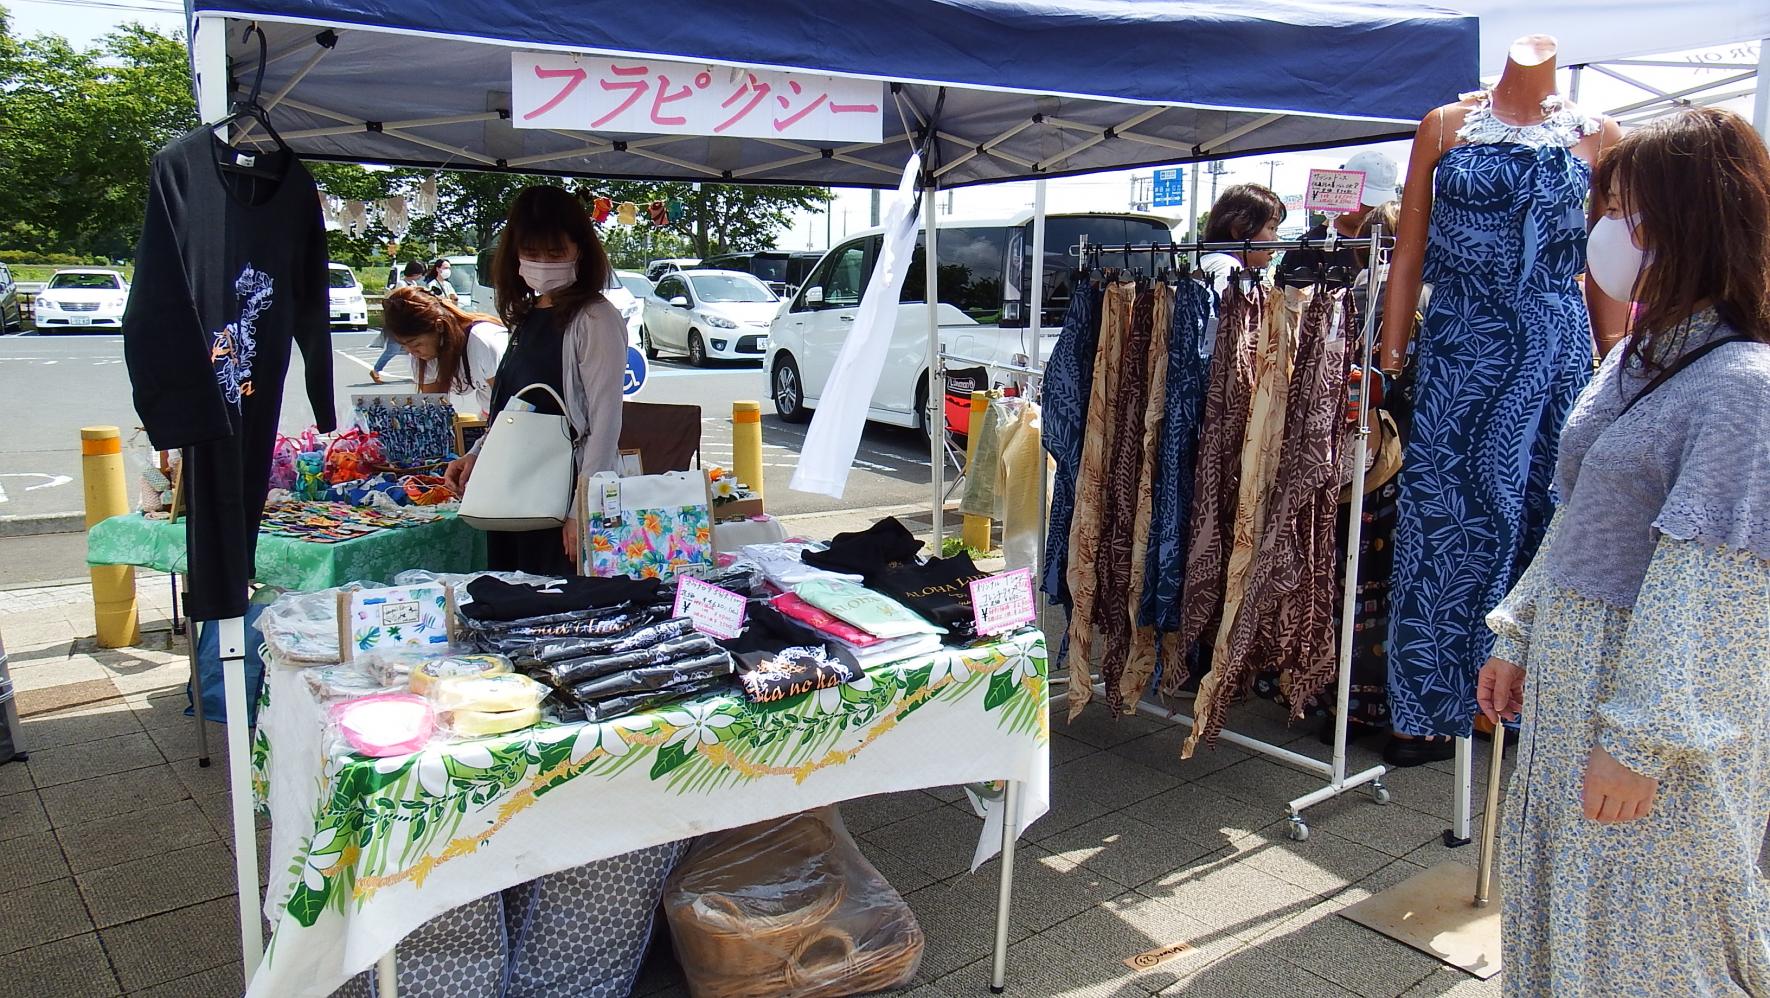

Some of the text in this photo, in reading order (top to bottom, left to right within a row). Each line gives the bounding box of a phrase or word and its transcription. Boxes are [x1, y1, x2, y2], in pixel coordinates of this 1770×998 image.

[523, 64, 879, 133] フラピクシー
[905, 584, 957, 598] ALOHA
